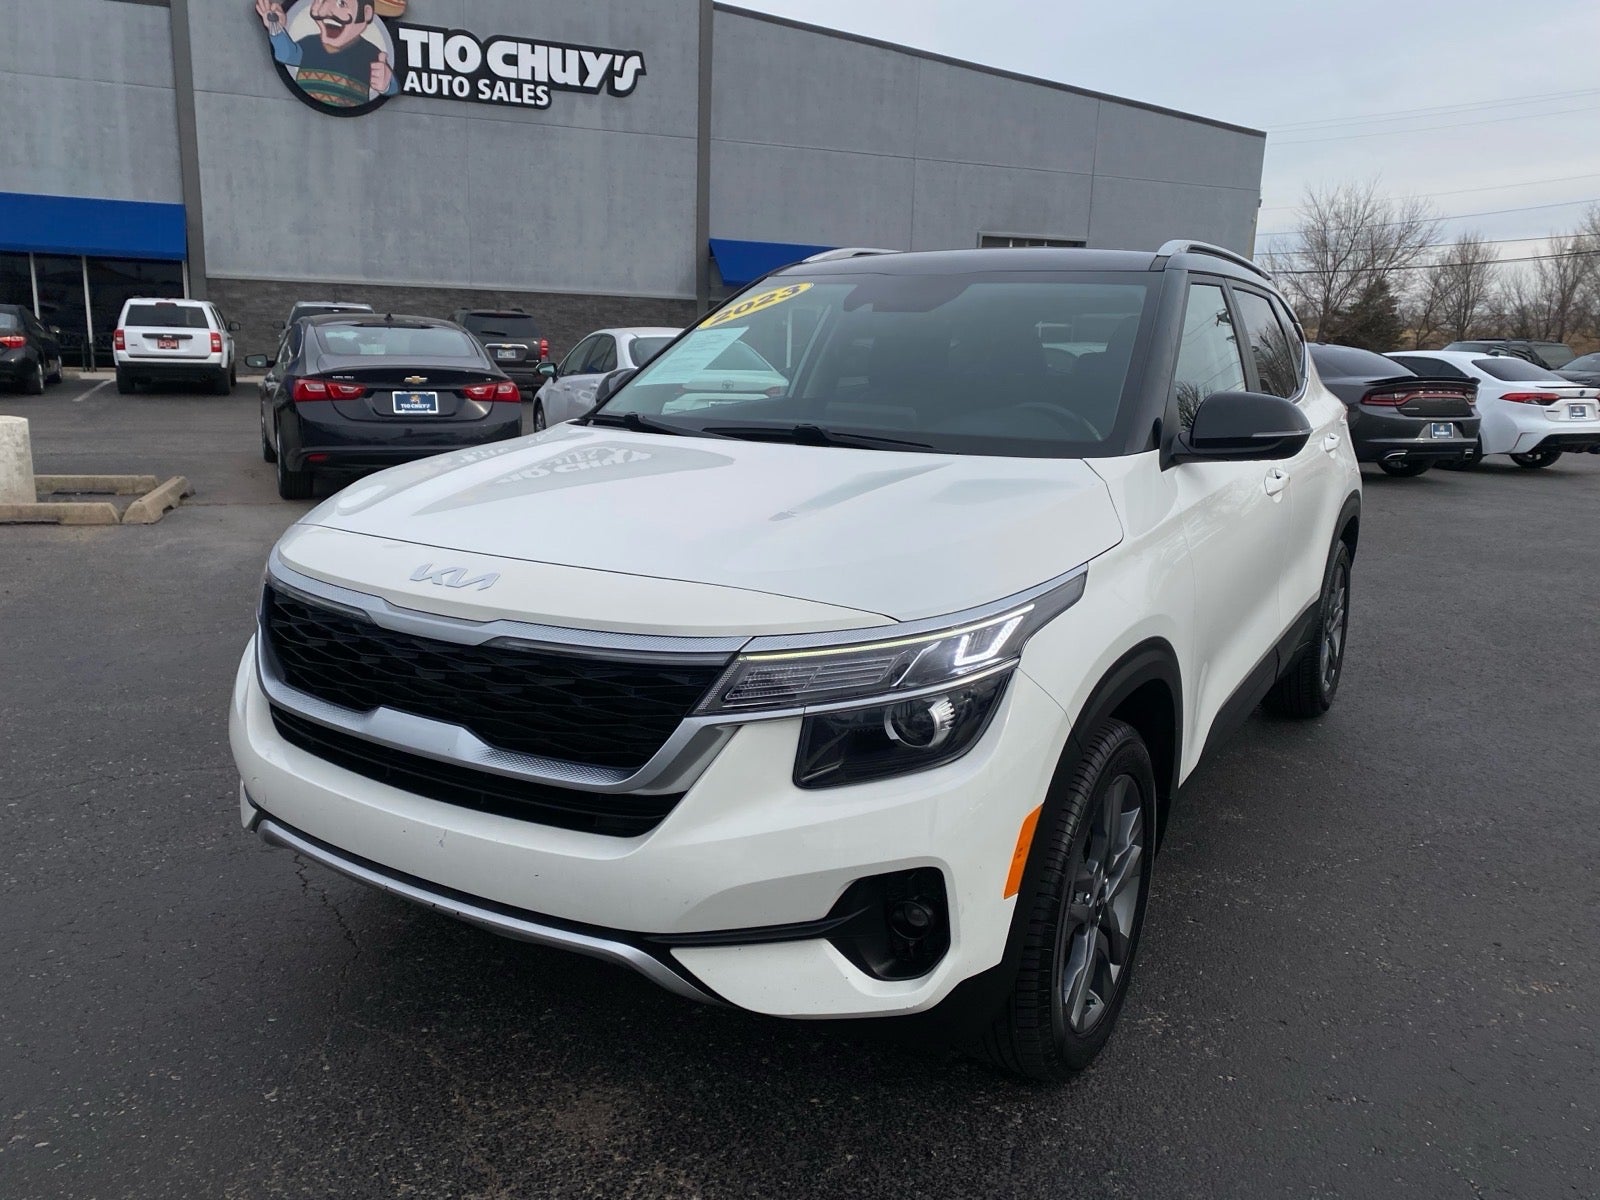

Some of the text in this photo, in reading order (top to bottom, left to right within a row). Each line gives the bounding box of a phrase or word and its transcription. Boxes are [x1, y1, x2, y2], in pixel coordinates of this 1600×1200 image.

[398, 27, 642, 92] TIO CHUY'S
[403, 71, 550, 106] AUTO SALES
[709, 285, 801, 326] 2023
[409, 561, 501, 591] KIA
